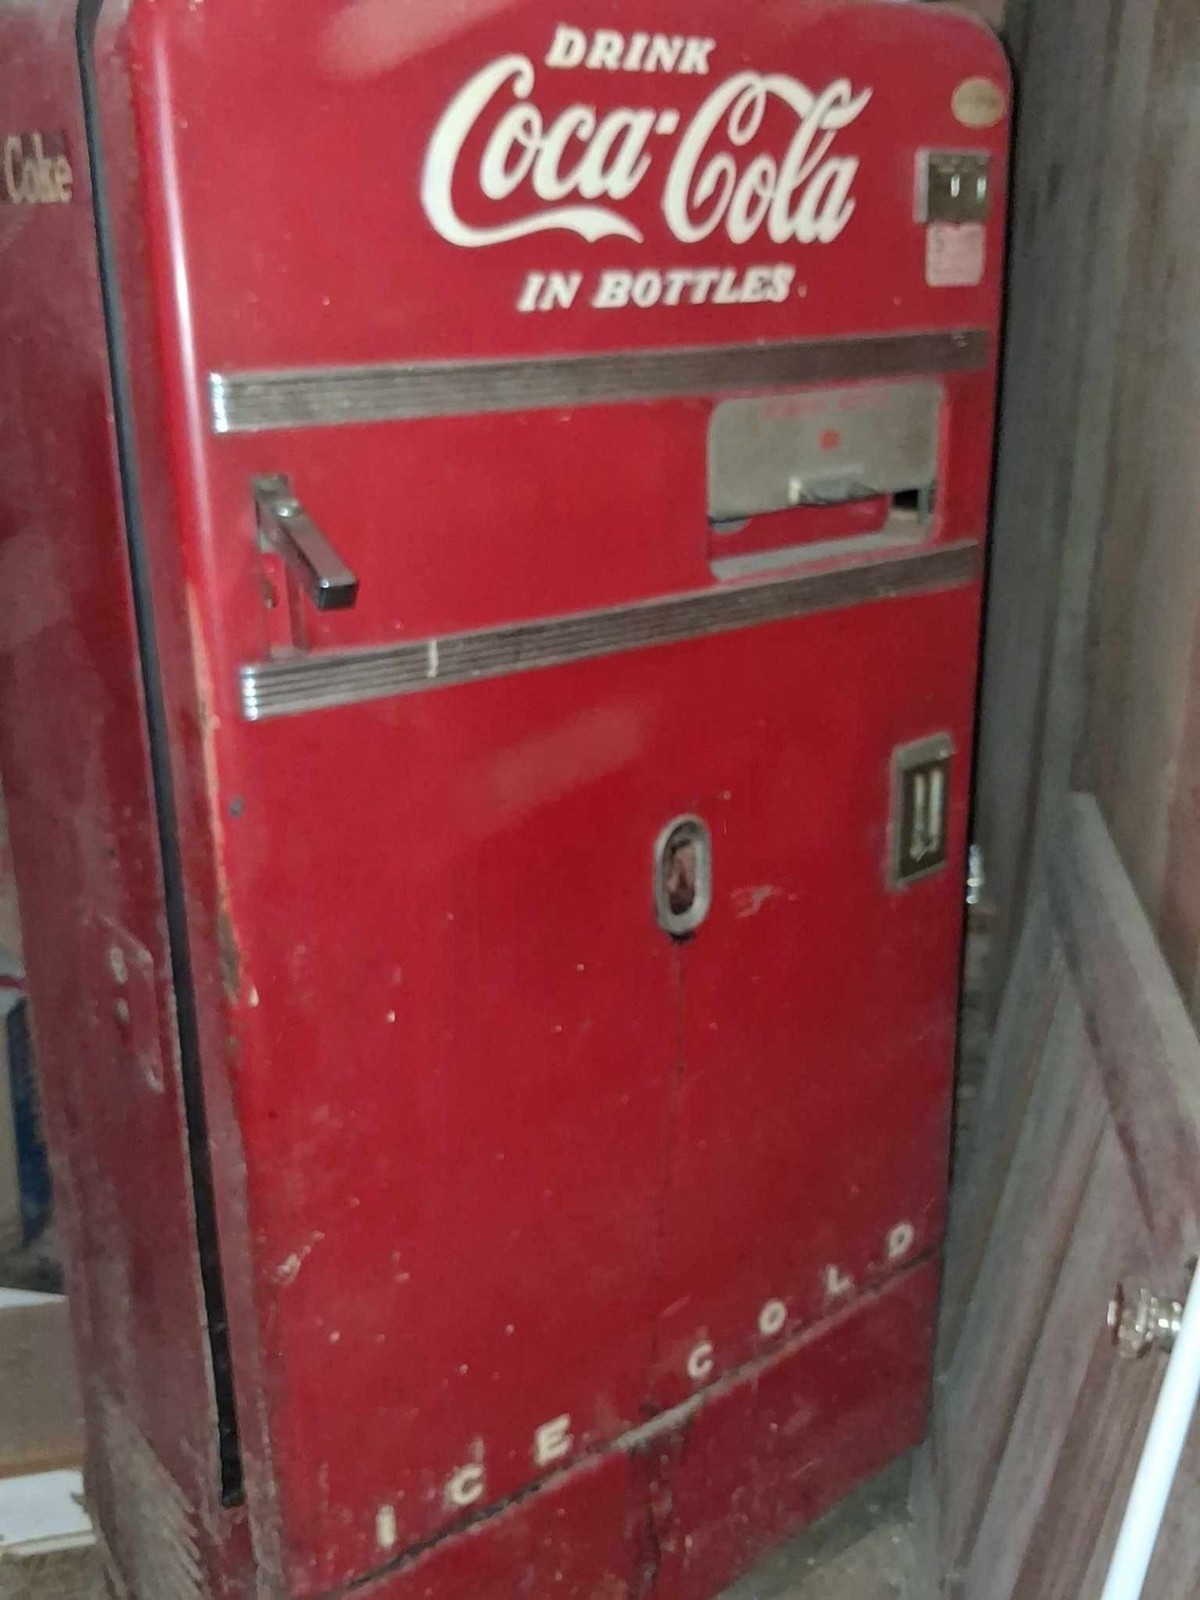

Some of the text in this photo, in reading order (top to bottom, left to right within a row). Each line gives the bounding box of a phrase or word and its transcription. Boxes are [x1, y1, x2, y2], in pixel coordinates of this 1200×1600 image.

[545, 23, 716, 76] DRINK
[4, 131, 73, 205] Coke
[421, 70, 874, 248] Coca-Cola
[516, 264, 796, 313] IN BOTTLES
[376, 1222, 915, 1551] ICE COLD
